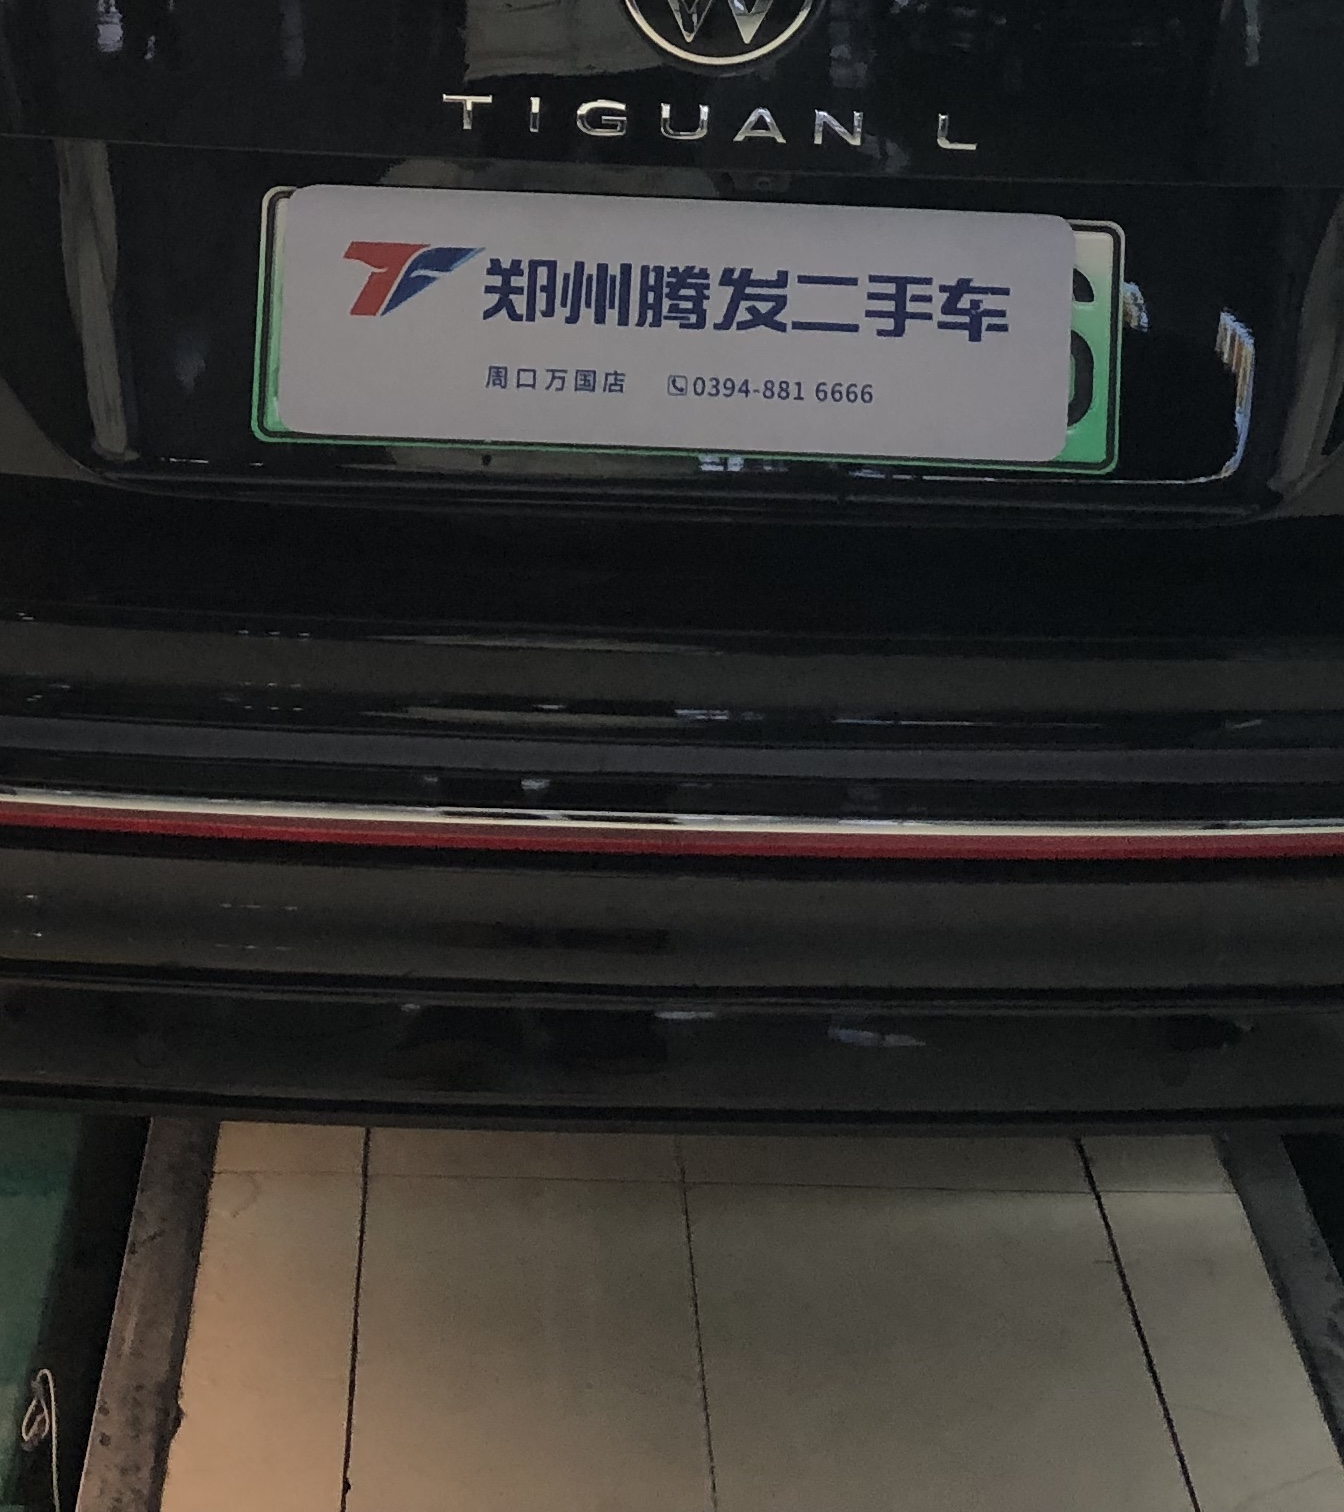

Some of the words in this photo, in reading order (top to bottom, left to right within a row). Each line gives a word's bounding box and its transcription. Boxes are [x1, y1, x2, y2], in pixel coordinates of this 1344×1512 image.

[443, 94, 864, 147] TIGUAN
[937, 113, 978, 151] L
[482, 258, 1011, 342] 郑州腾发二手车
[484, 365, 626, 394] 周口万国店
[693, 376, 804, 401] 0394-881
[815, 381, 875, 404] 6666
